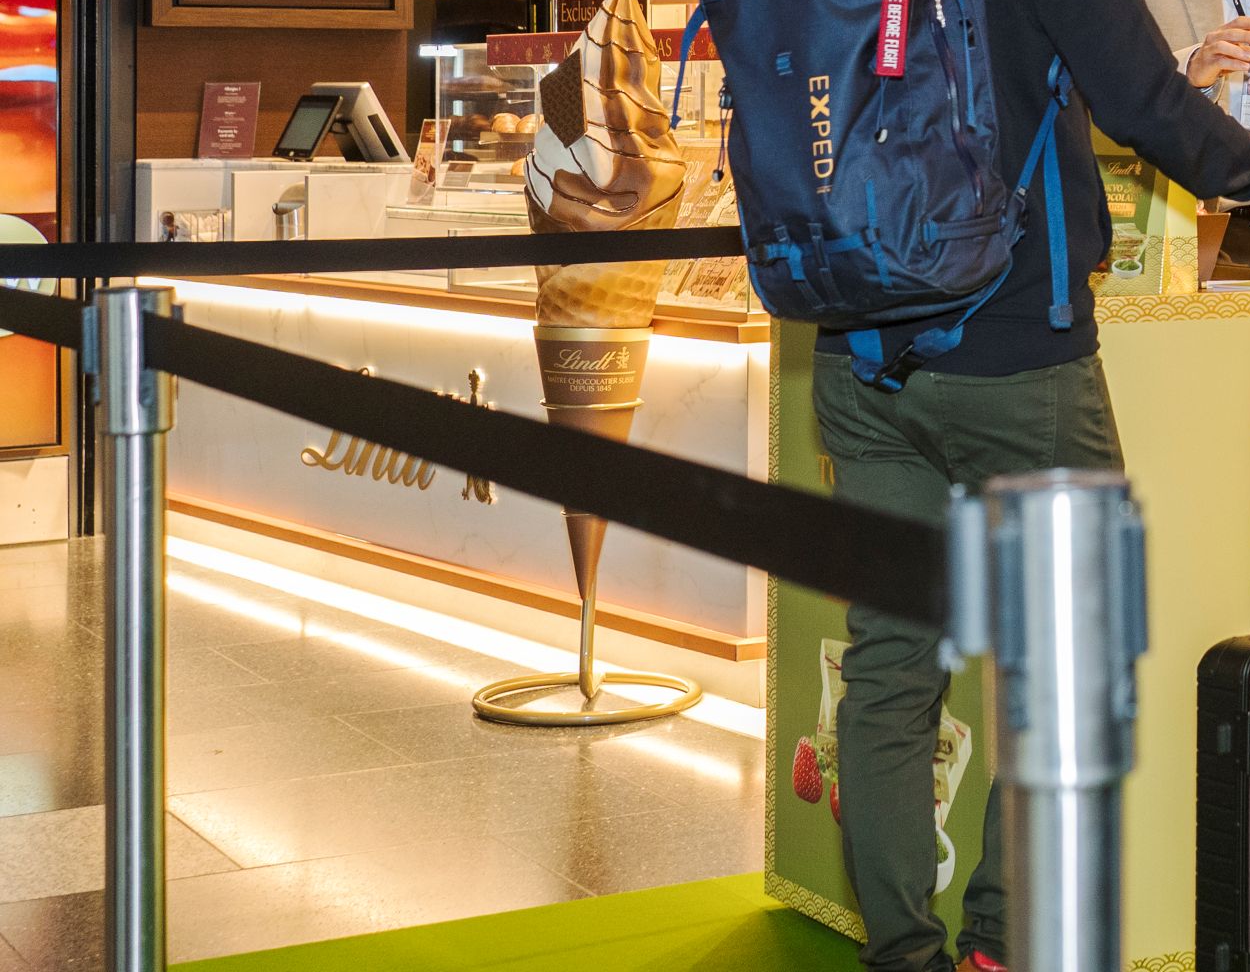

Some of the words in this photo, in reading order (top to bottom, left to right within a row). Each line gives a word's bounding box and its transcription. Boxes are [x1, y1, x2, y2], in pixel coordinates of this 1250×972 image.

[885, 3, 902, 38] BEFORE
[882, 38, 900, 69] FLIGHT
[808, 75, 834, 179] EXPED
[1107, 161, 1136, 176] Lindt
[553, 349, 617, 371] Lindt
[568, 376, 618, 386] CHOCOLATIER
[569, 384, 595, 392] DEPUIS
[597, 384, 613, 392] 1845
